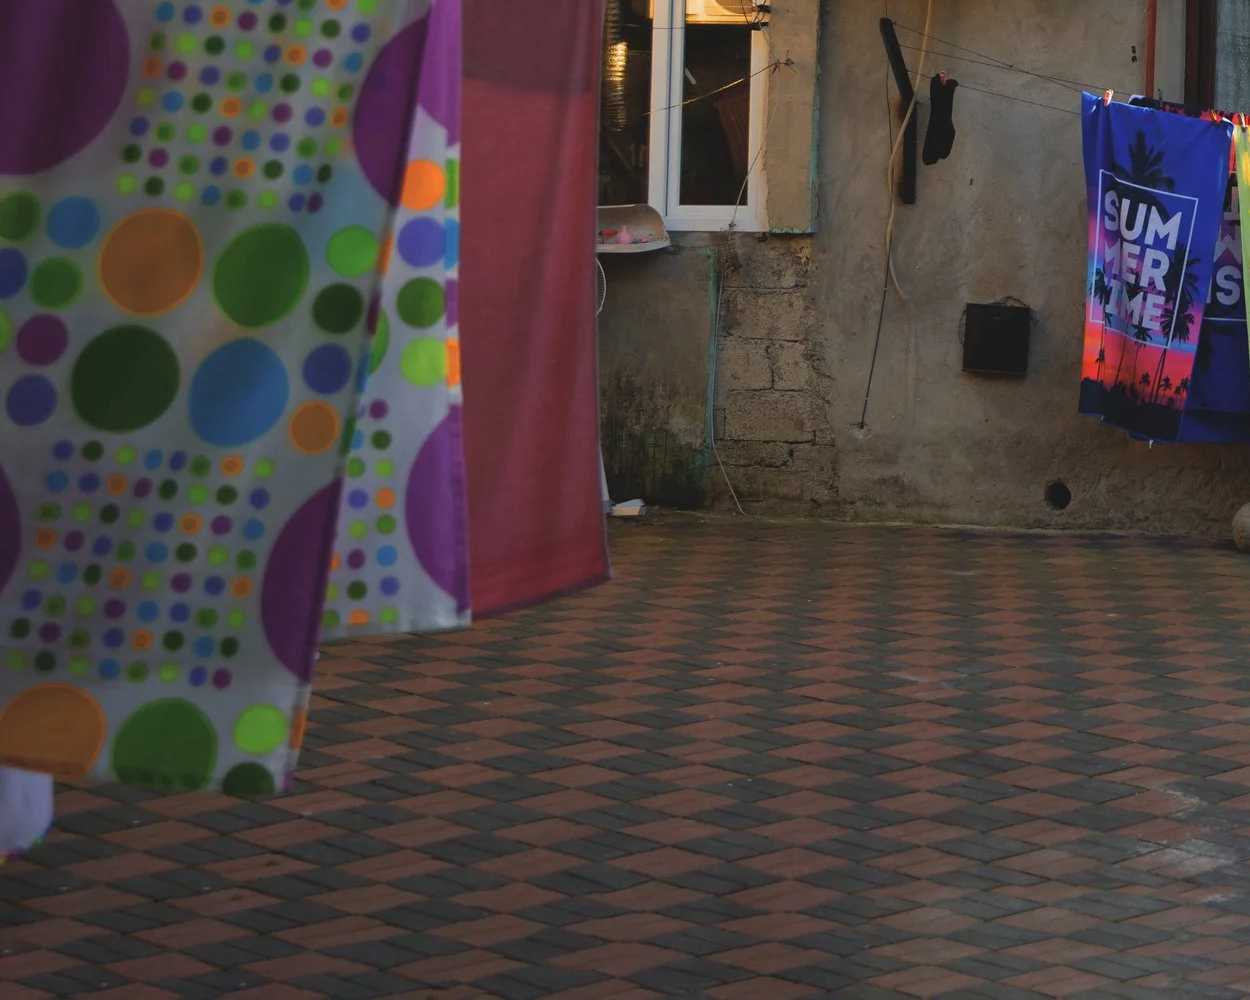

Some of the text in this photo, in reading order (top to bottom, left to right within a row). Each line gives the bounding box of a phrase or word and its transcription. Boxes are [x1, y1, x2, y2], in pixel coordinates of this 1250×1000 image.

[1104, 190, 1182, 250] SUM
[1104, 238, 1170, 293] MER
[1104, 277, 1167, 330] IME
